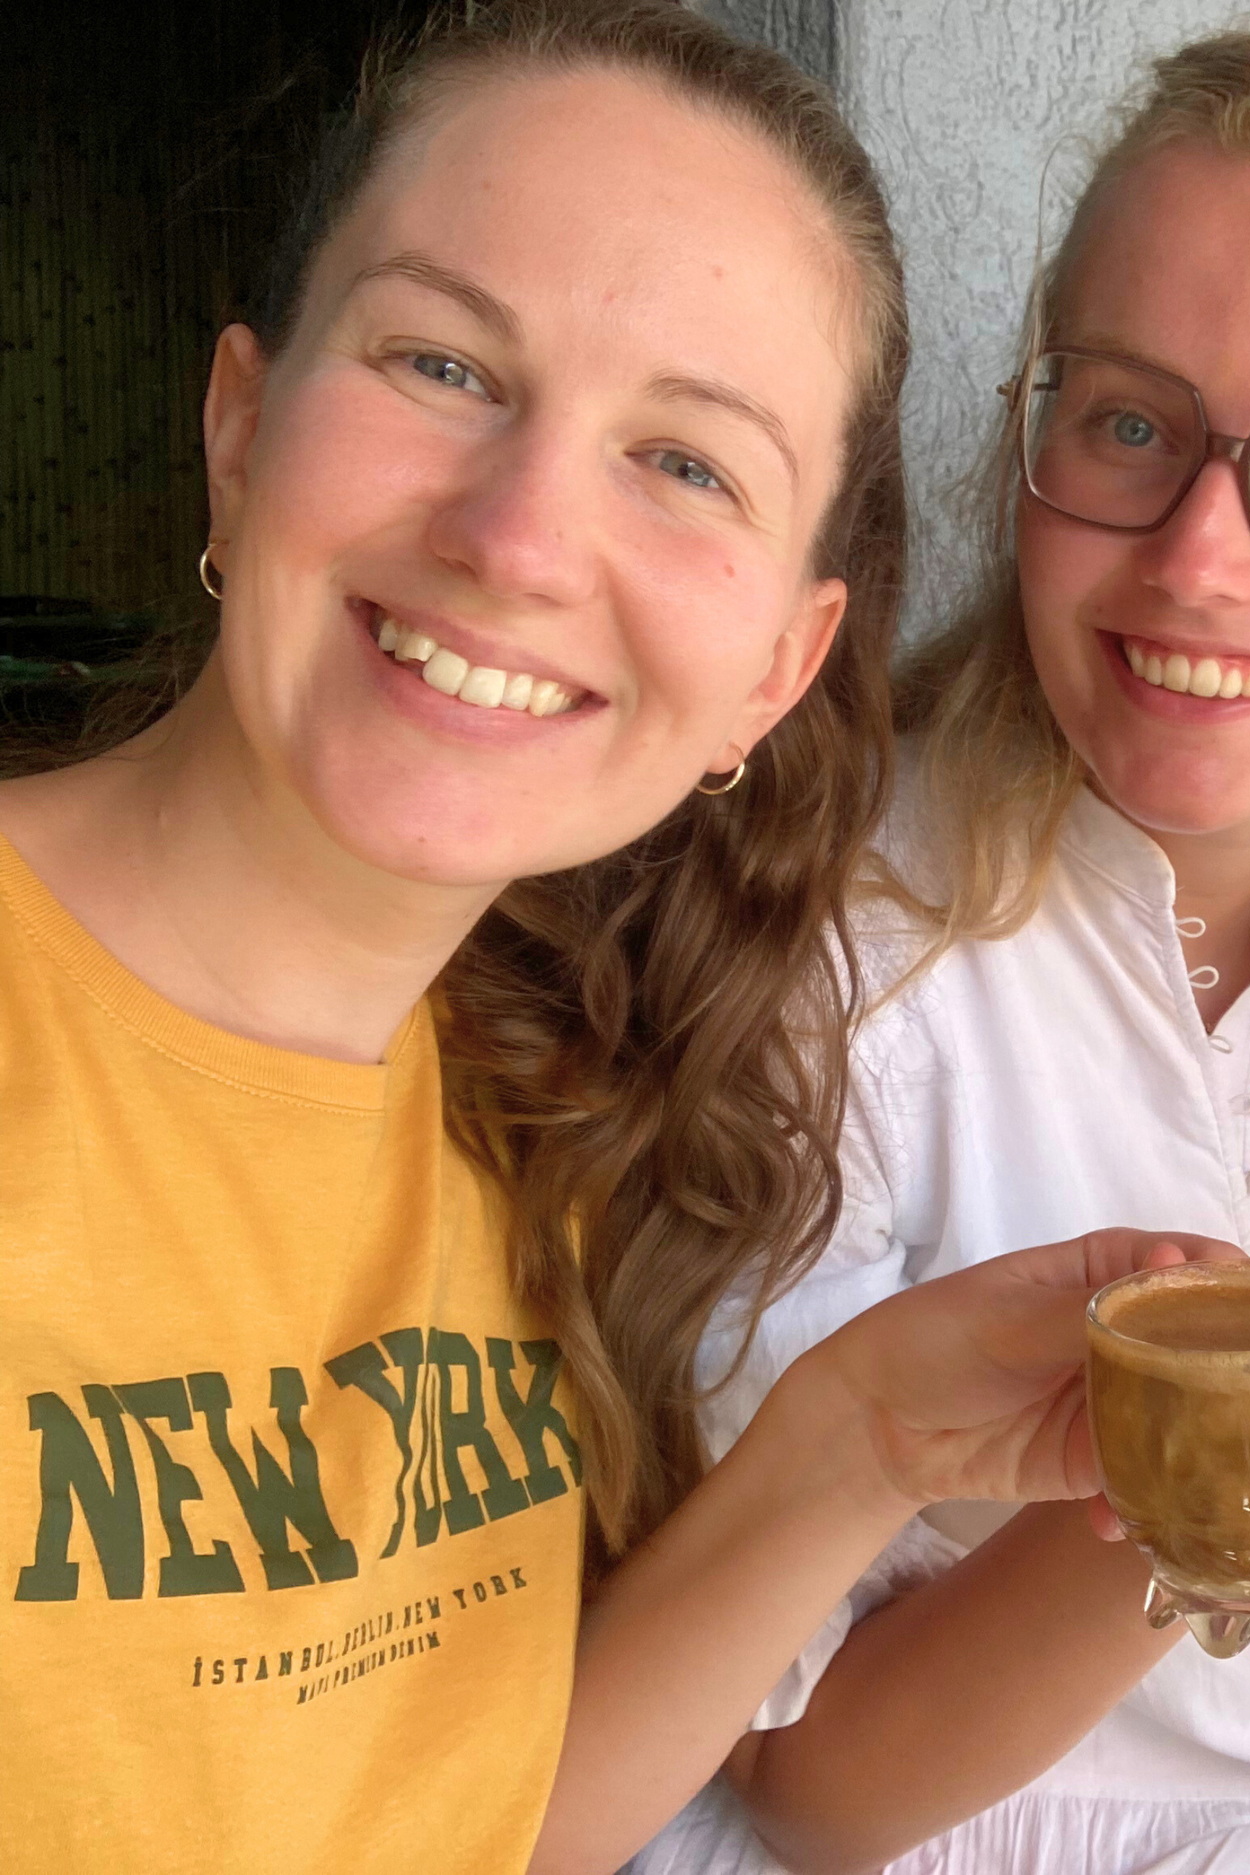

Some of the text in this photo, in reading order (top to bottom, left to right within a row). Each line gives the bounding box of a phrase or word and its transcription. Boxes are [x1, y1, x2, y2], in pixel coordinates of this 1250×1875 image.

[14, 1326, 584, 1602] NEW YORK
[453, 1567, 527, 1609] YORK
[333, 1648, 386, 1688] PREMIUM
[390, 1631, 441, 1662] DENIM
